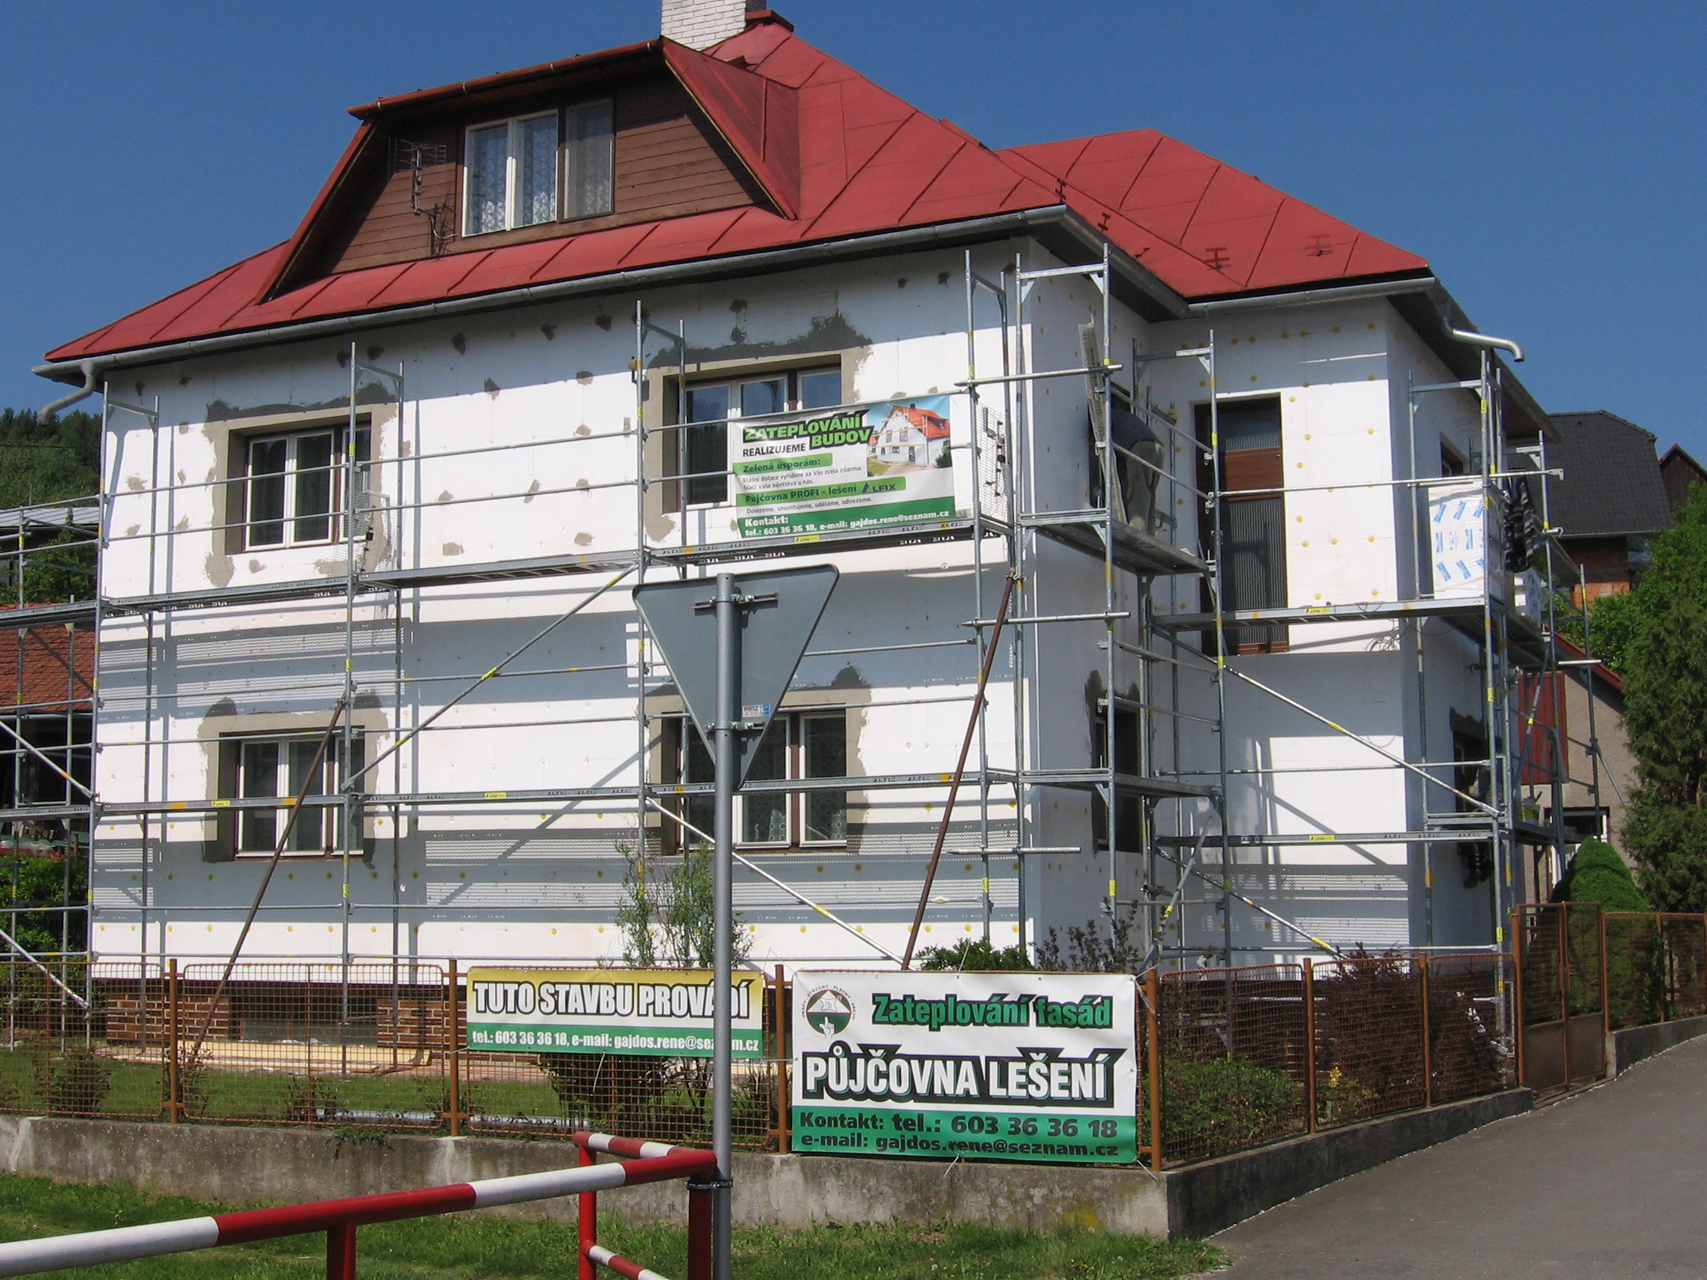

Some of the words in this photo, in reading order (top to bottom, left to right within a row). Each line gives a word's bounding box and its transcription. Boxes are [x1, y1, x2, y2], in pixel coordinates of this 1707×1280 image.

[744, 415, 861, 440] ZATEPLOVÁNÍ
[811, 428, 871, 447] BUDOV
[742, 443, 806, 457] REALIZUJEME
[743, 462, 774, 473] Zelená
[777, 458, 821, 470] úsporám:
[790, 489, 819, 499] PROFI
[828, 483, 857, 494] lešení
[745, 515, 789, 527] Kontakt:
[745, 528, 762, 536] tel.:
[763, 526, 779, 535] 603
[780, 525, 791, 534] 36
[792, 524, 803, 533] 36
[805, 522, 817, 532] 18,
[819, 520, 848, 530] e-mail:
[850, 511, 950, 528] gajdos.rene@seznam.cz
[473, 983, 535, 1014] TUTO
[539, 983, 635, 1016] STAVBU
[873, 994, 1032, 1030] Zateplování
[1036, 996, 1112, 1028] fasád
[472, 1030, 493, 1043] tel.:
[495, 1030, 517, 1044] 603
[519, 1031, 535, 1045] 36
[536, 1031, 552, 1045] 36
[554, 1032, 570, 1047] 18,
[571, 1033, 612, 1047] e-mail:
[614, 1033, 759, 1051] gajdos.rene@sem.cz
[805, 1044, 981, 1098] PŮJČOVNA
[987, 1052, 1110, 1099] LEŠENÍ
[800, 1112, 884, 1130] Kontakt:
[892, 1113, 941, 1132] tel.:
[951, 1115, 999, 1136] 603
[1007, 1116, 1038, 1136] 36
[1047, 1118, 1078, 1137] 36
[1087, 1119, 1118, 1138] 18
[801, 1132, 869, 1148] e-mail:
[875, 1135, 1119, 1157] gajdos.rene@seznam.cz
